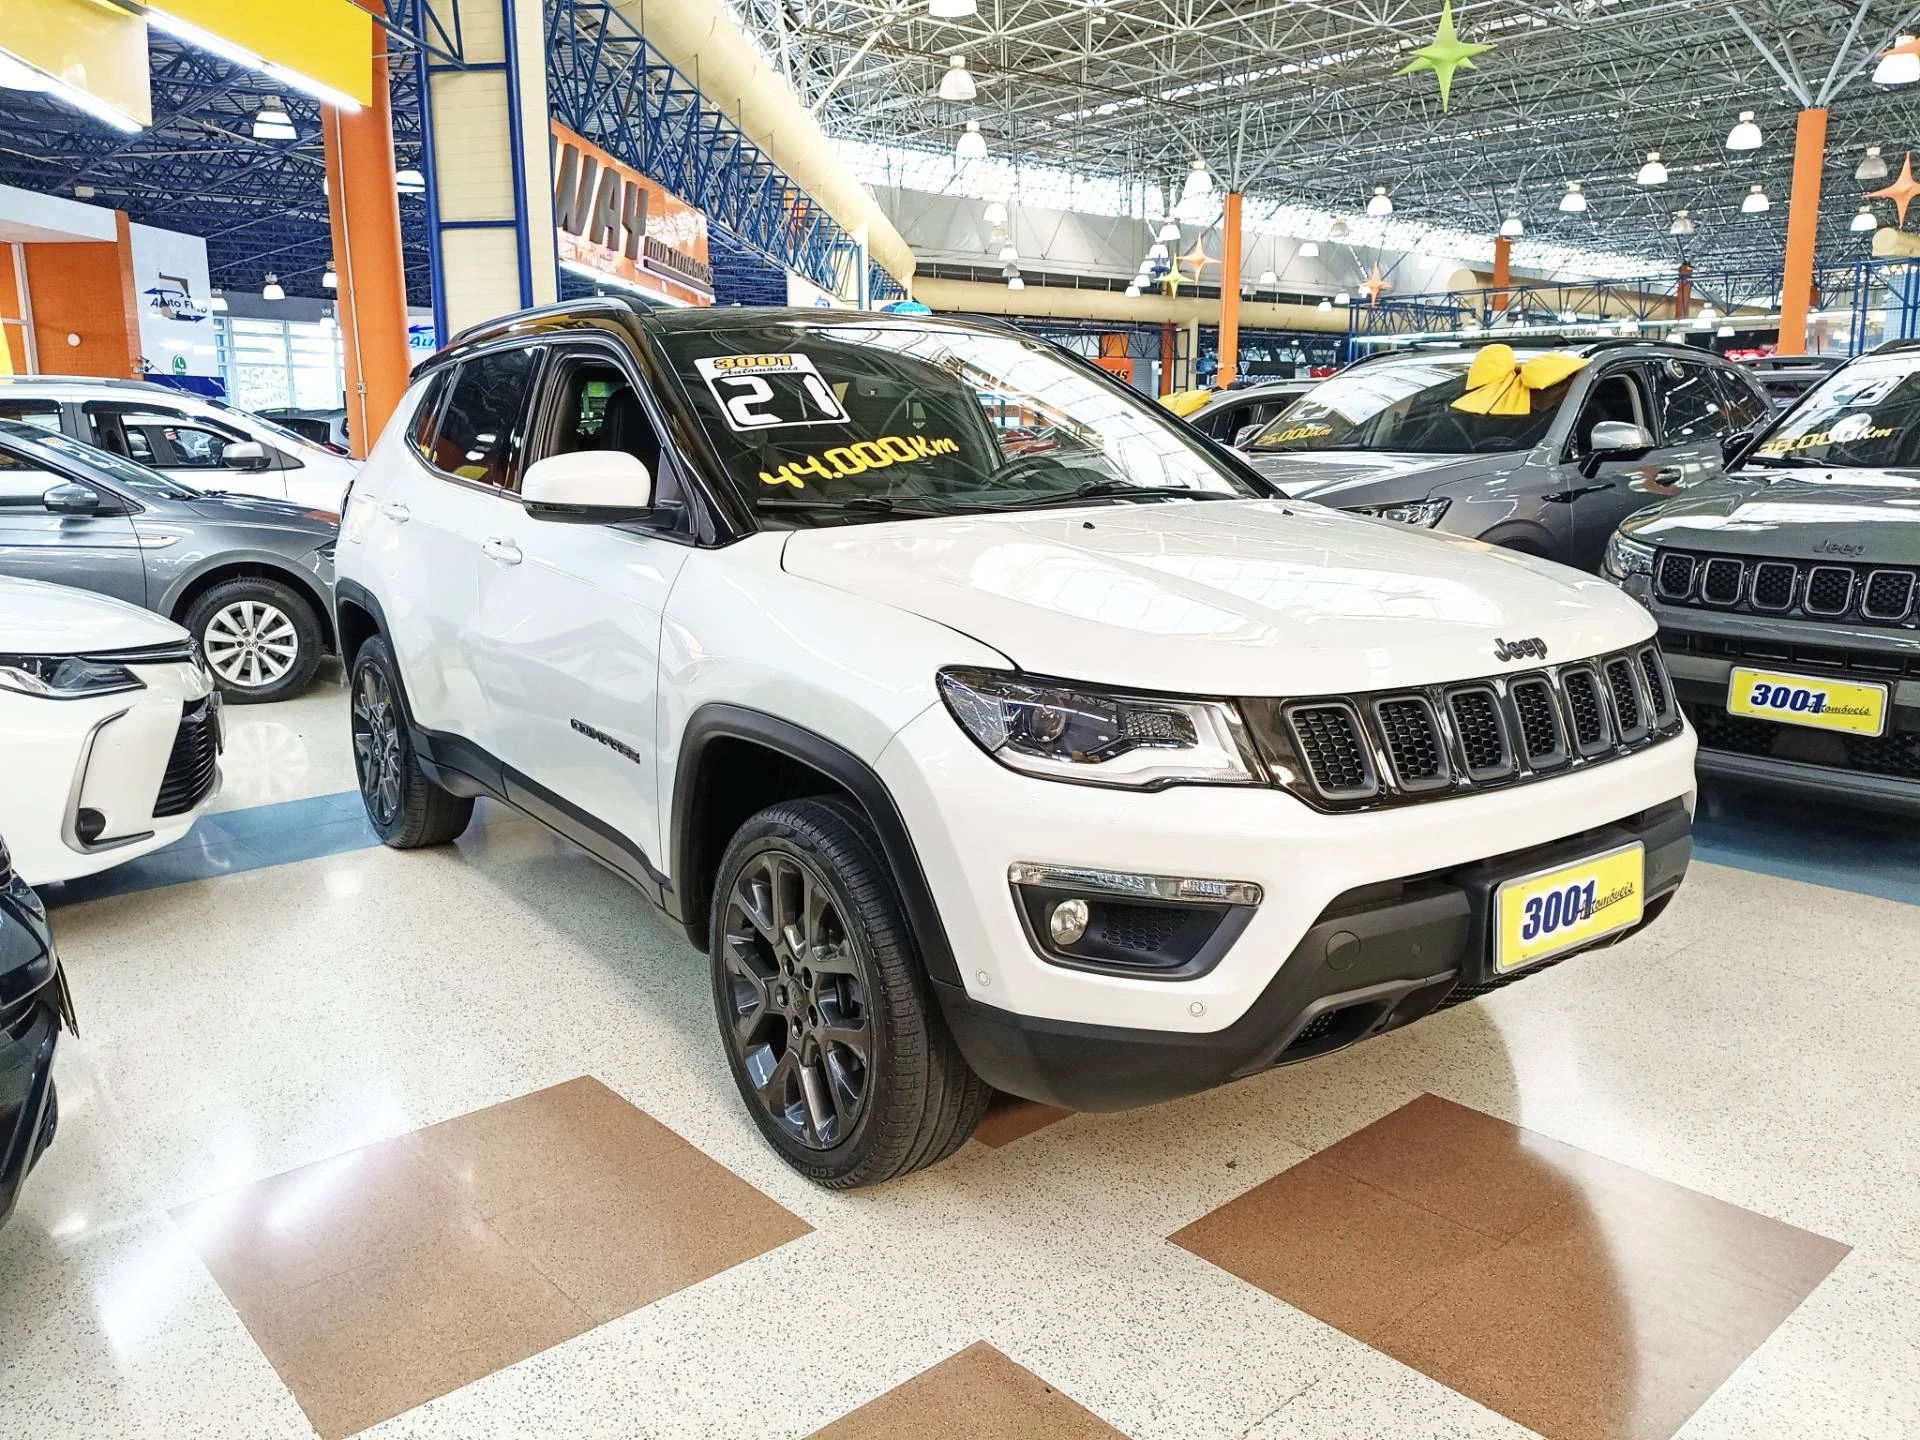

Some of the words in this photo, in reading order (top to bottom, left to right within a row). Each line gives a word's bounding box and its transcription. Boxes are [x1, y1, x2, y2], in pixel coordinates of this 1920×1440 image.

[713, 355, 793, 370] 3001
[720, 373, 841, 426] 21
[1812, 538, 1866, 559] Jeep
[1494, 636, 1548, 662] Jeep
[1750, 683, 1827, 715] 3001
[1522, 880, 1596, 940] 3001
